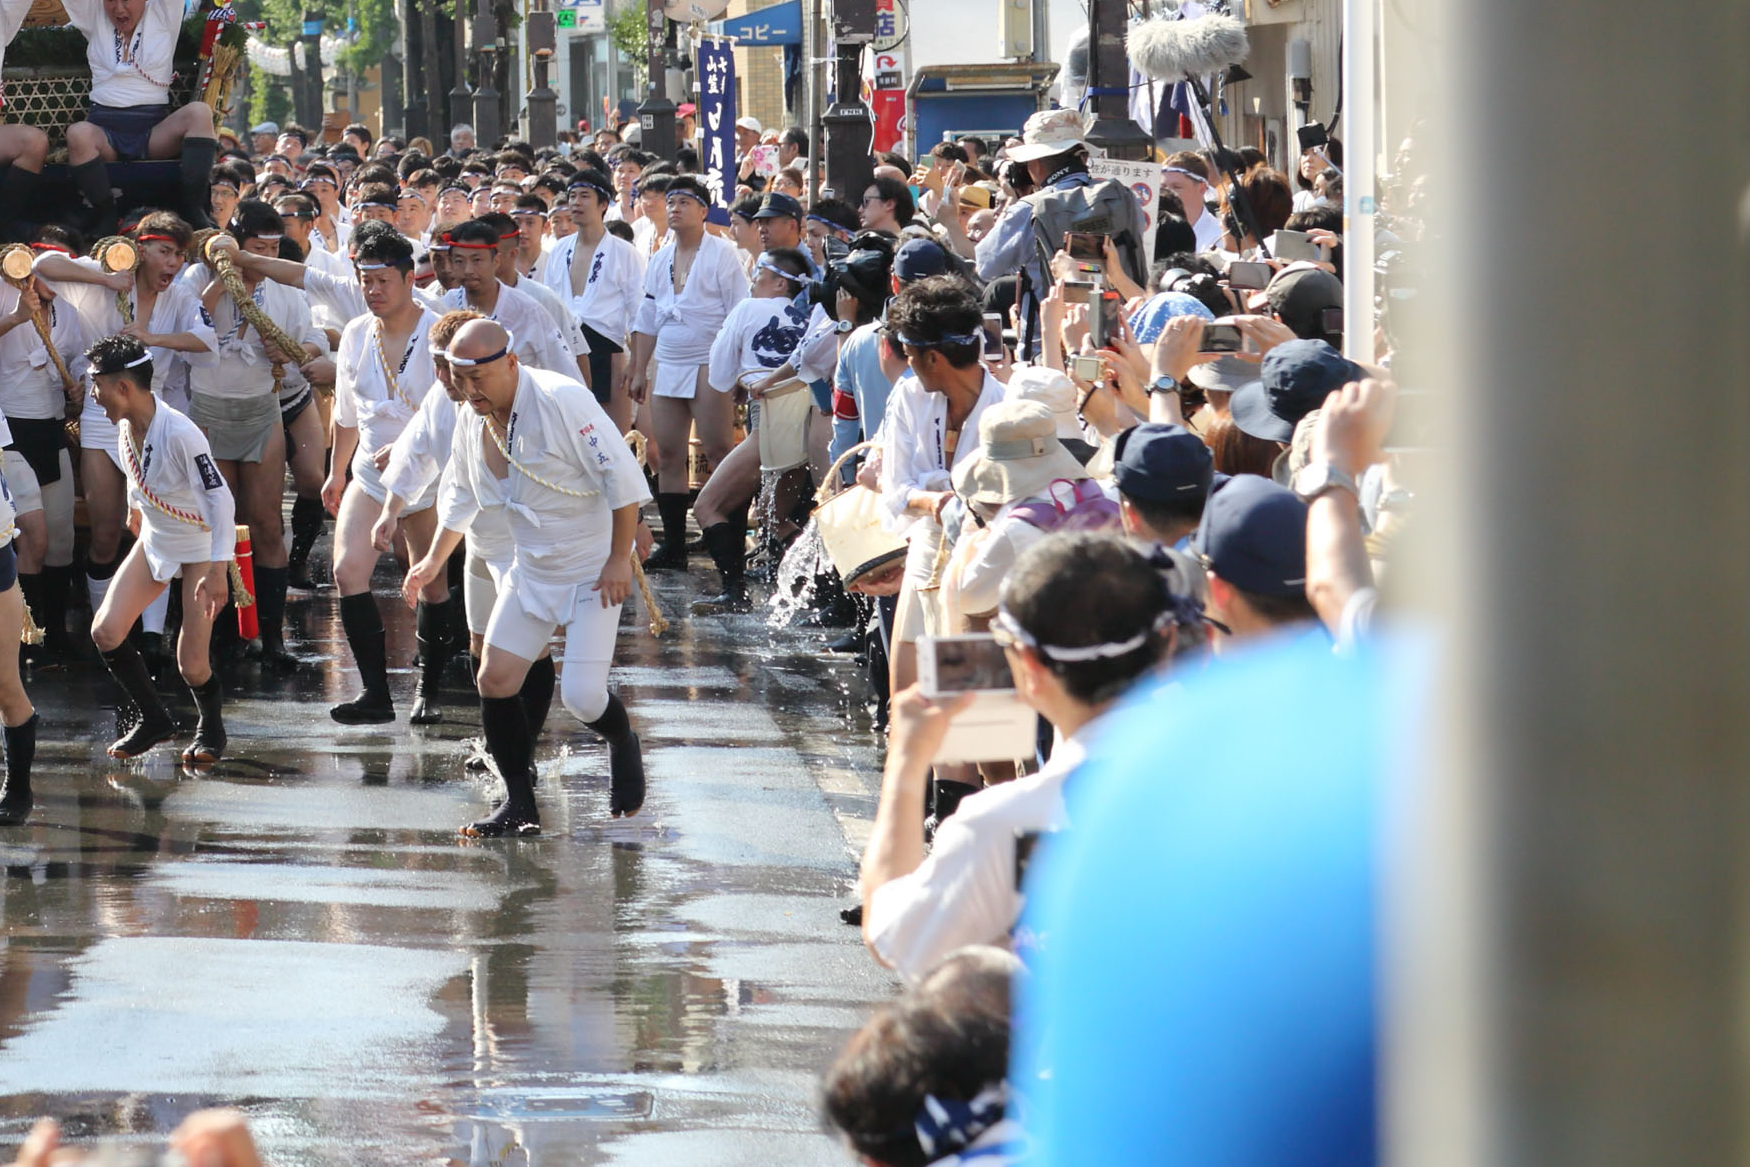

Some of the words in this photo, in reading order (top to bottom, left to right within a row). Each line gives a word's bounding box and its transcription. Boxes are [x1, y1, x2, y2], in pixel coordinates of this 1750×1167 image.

[739, 24, 787, 40] コピー
[1046, 166, 1070, 185] SONY
